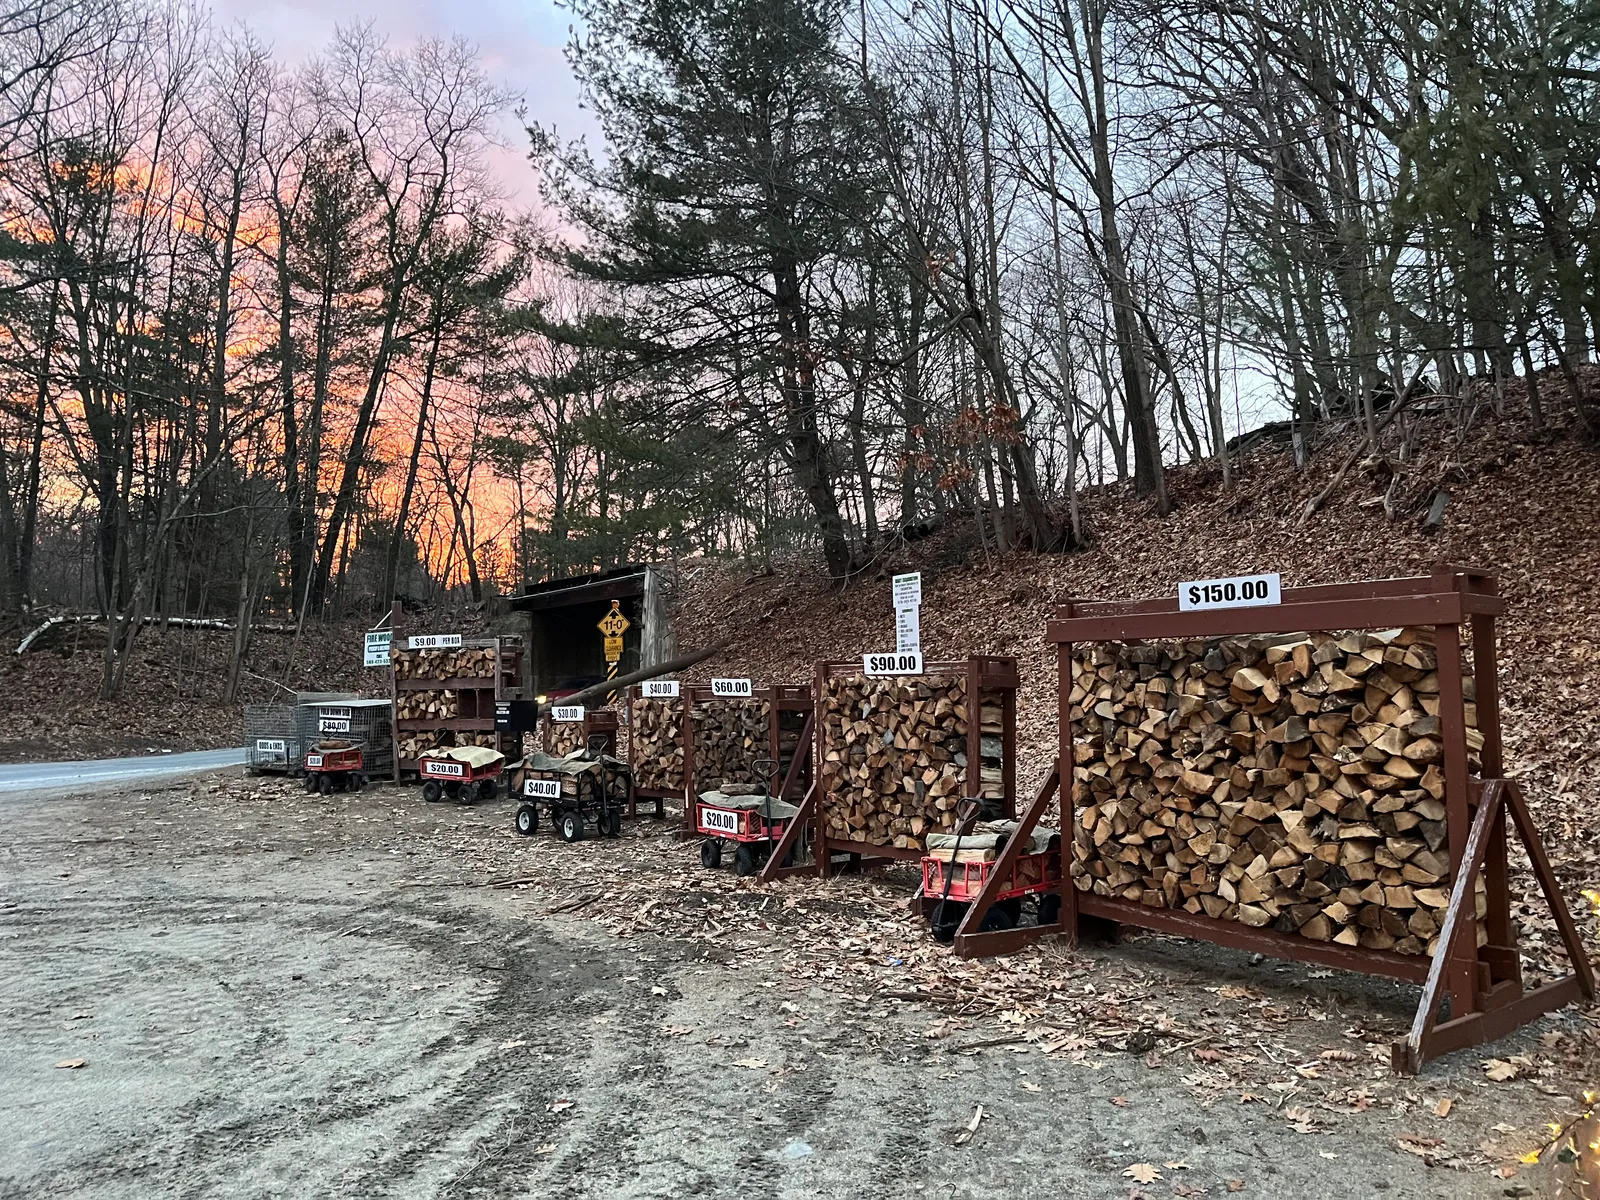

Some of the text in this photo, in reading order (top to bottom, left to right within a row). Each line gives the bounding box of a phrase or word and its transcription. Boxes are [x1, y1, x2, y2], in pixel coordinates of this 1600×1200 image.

[1188, 580, 1268, 605] $150.00
[366, 634, 378, 643] FIRE
[414, 636, 460, 646] $9.00 PER BOX
[870, 656, 916, 672] $90.00
[649, 683, 672, 694] $40.00
[714, 681, 748, 693] $60.00
[557, 708, 578, 719] $30.00
[322, 720, 347, 731] $80.00
[258, 741, 269, 750] ODDS
[273, 742, 283, 750] ENDS
[430, 764, 459, 774] $20.00
[528, 783, 556, 795] $40.00
[706, 813, 734, 829] $20.00
